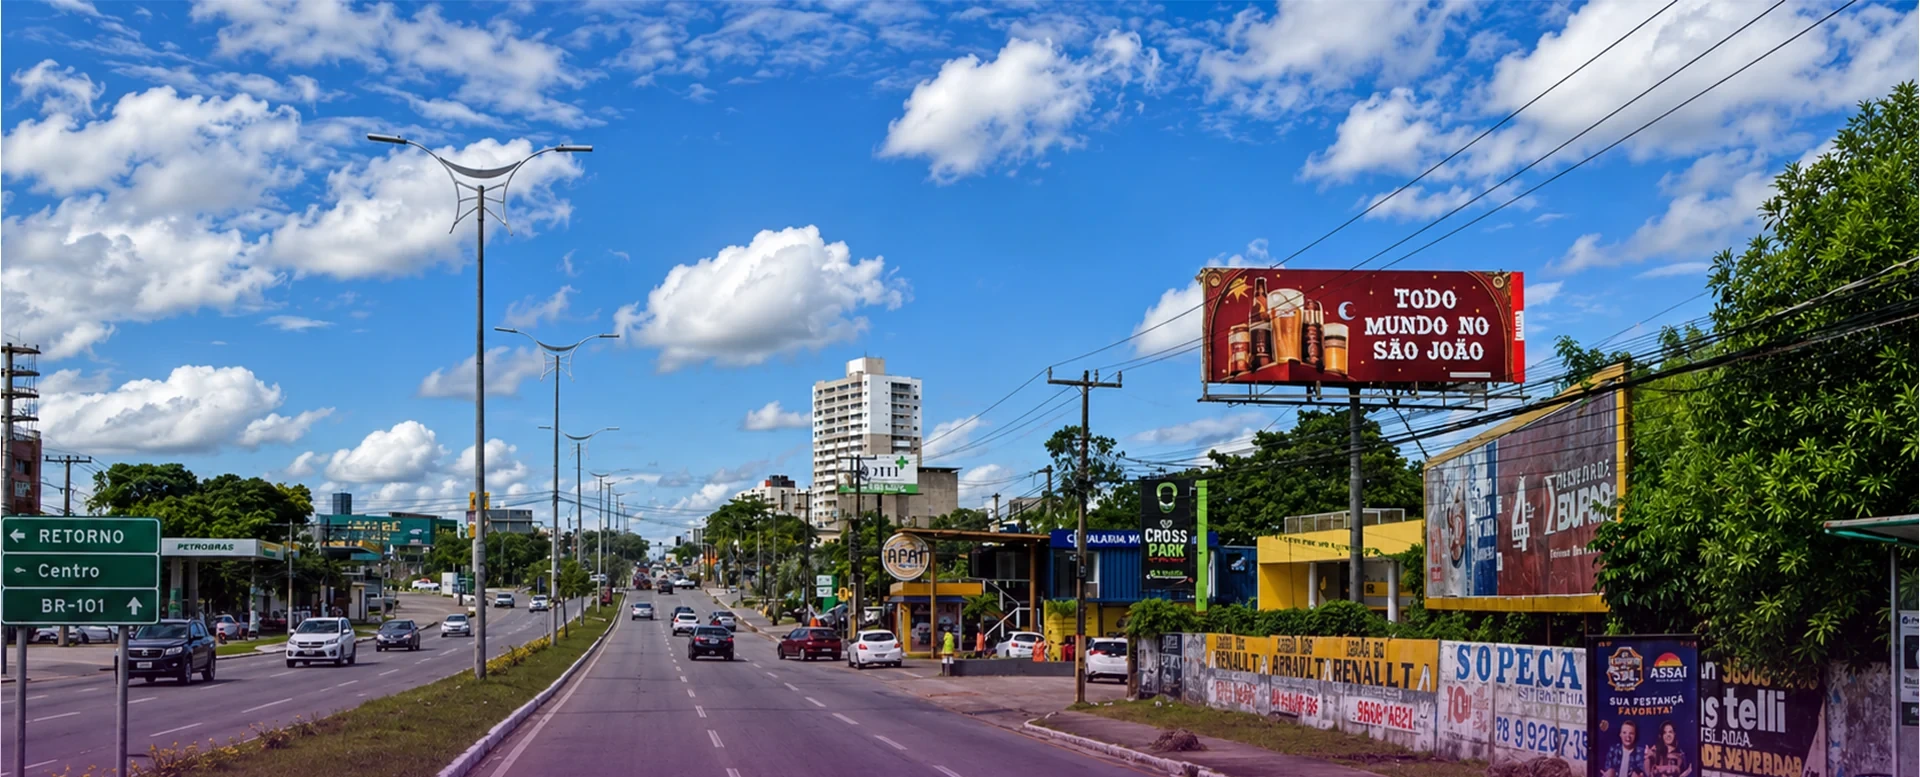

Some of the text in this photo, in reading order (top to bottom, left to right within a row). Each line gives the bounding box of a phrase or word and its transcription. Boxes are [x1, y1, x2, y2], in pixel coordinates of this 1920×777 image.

[1394, 288, 1457, 309] TODO
[1364, 315, 1490, 336] MUNDO NO
[39, 529, 125, 544] RETORNO
[1145, 528, 1188, 543] CROSS
[177, 543, 234, 551] PETROBRAS
[1149, 543, 1185, 557] PARK
[38, 563, 100, 578] Centro
[41, 599, 104, 613] BR-101
[1456, 644, 1583, 690] SOPECA
[1609, 697, 1630, 706] SUA
[1618, 706, 1673, 716] FAVORITA!
